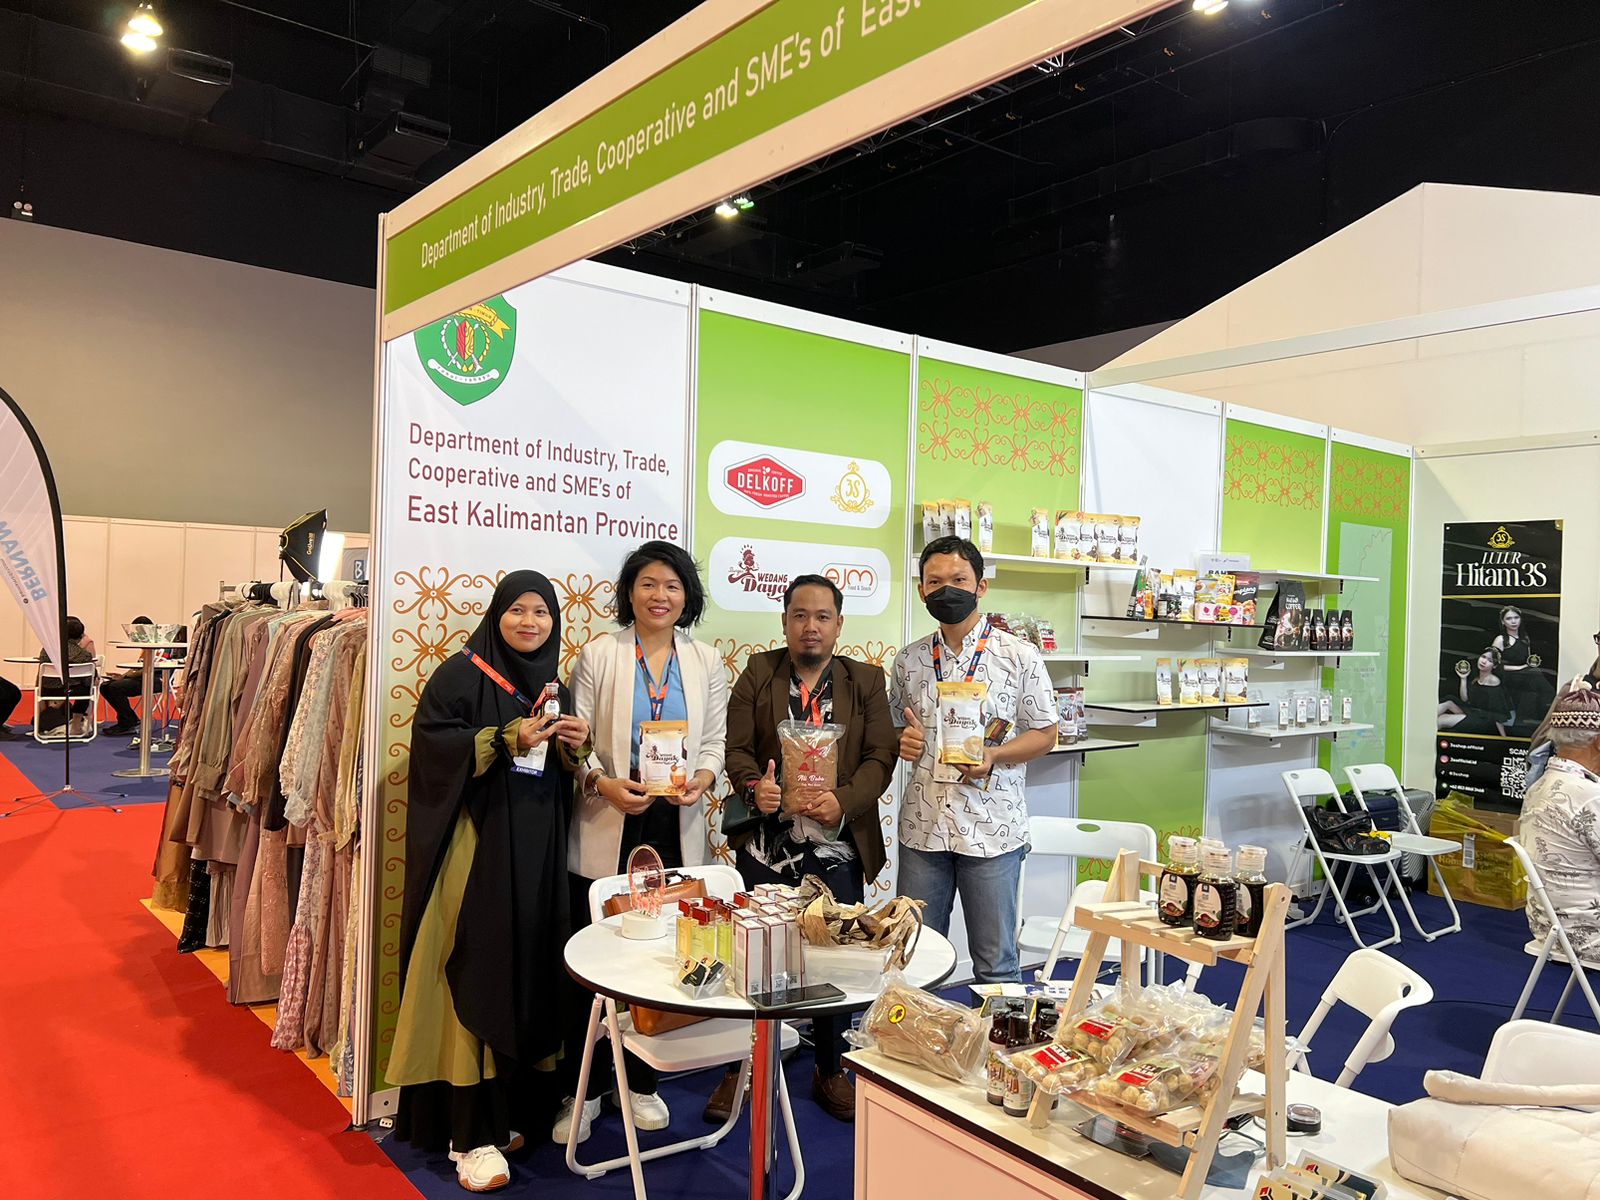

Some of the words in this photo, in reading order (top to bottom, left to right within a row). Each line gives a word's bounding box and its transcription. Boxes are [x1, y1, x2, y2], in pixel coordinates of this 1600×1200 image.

[421, 213, 479, 269] Department
[481, 204, 492, 236] of
[494, 182, 547, 216] Industry,
[550, 154, 592, 199] Trade,
[596, 101, 697, 175] Cooperative
[702, 66, 739, 121] and
[745, 31, 812, 98] SME's
[820, 16, 845, 58] of
[861, 0, 921, 38] Eas
[409, 422, 519, 457] Department
[525, 439, 543, 460] of
[547, 440, 619, 473] Industry,
[622, 449, 671, 477] Trade,
[408, 457, 520, 490] Cooperative
[525, 472, 557, 494] and
[562, 474, 611, 499] SME's
[616, 481, 632, 501] of
[737, 472, 794, 493] DELKOFF
[407, 495, 459, 526] East
[467, 500, 588, 536] Kalimantan
[595, 511, 679, 541] Province
[741, 577, 793, 599] Daya
[757, 572, 788, 583] WEDANG
